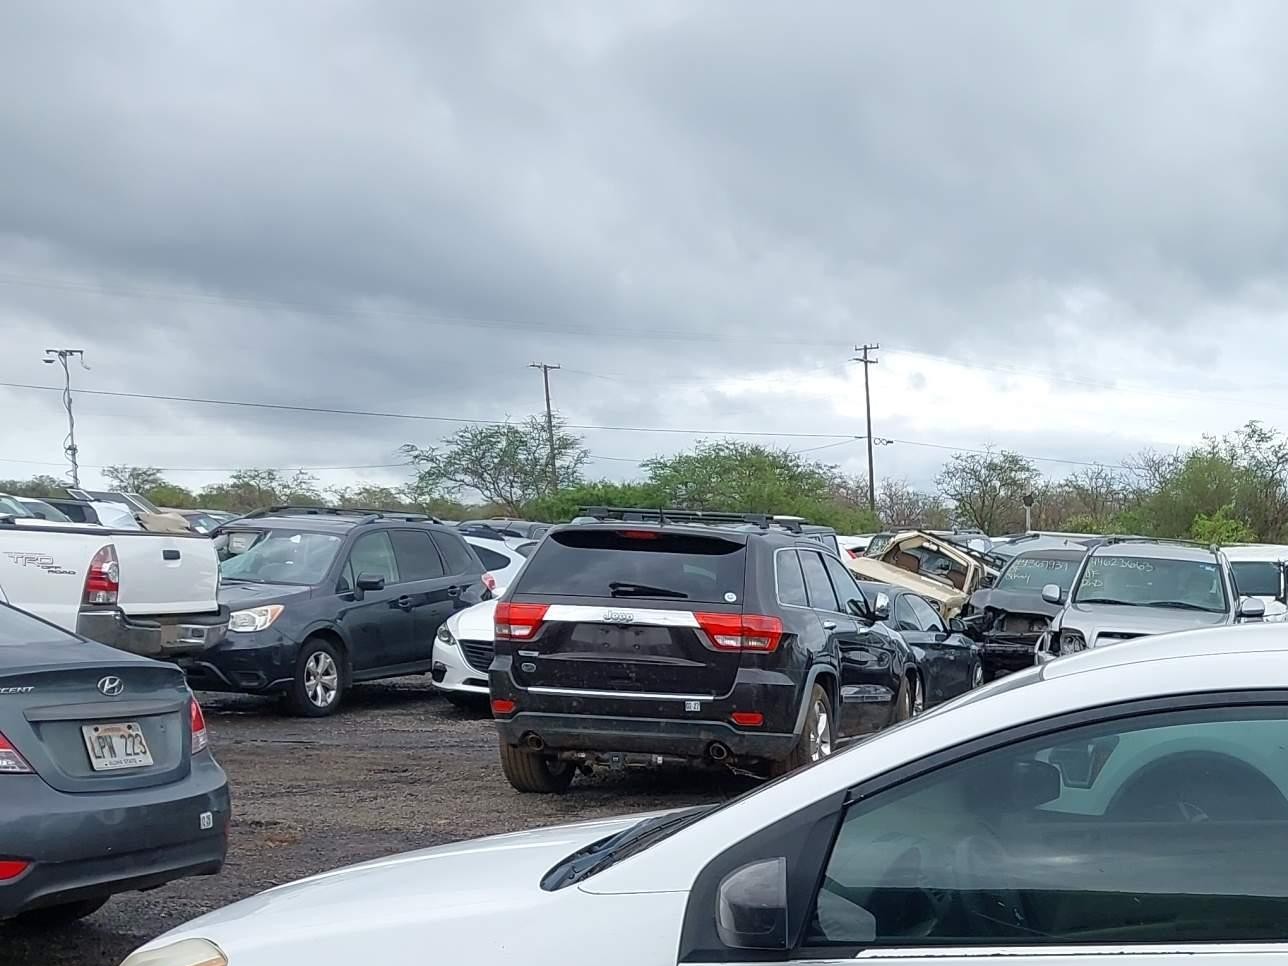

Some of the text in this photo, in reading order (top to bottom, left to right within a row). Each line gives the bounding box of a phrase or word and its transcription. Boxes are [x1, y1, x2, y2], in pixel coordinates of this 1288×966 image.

[8, 555, 54, 567] TRD
[602, 609, 635, 623] Jeep
[120, 733, 147, 756] 223
